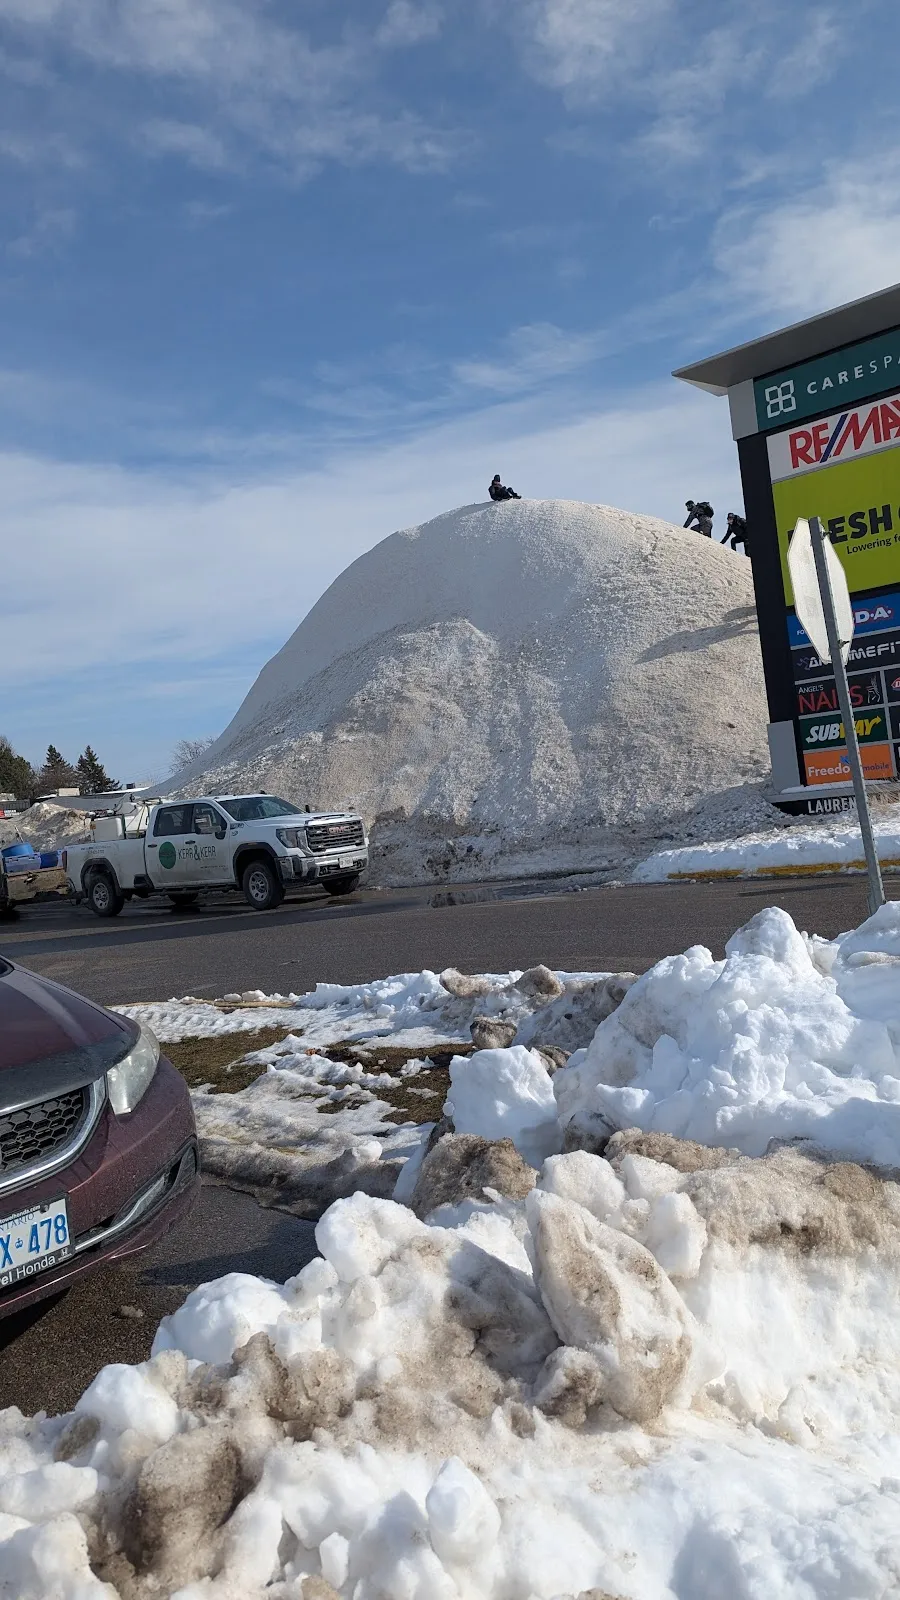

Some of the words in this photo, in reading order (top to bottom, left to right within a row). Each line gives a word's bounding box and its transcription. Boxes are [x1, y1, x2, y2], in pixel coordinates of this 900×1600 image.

[806, 355, 900, 394] CARESP
[787, 504, 892, 545] ESH
[846, 537, 892, 555] Lowering
[798, 685, 864, 713] NAIS
[807, 762, 851, 777] Freedo
[807, 796, 856, 814] LAUREN
[28, 1214, 68, 1255] 478
[0, 1271, 13, 1285] el
[16, 1255, 56, 1279] Honda
